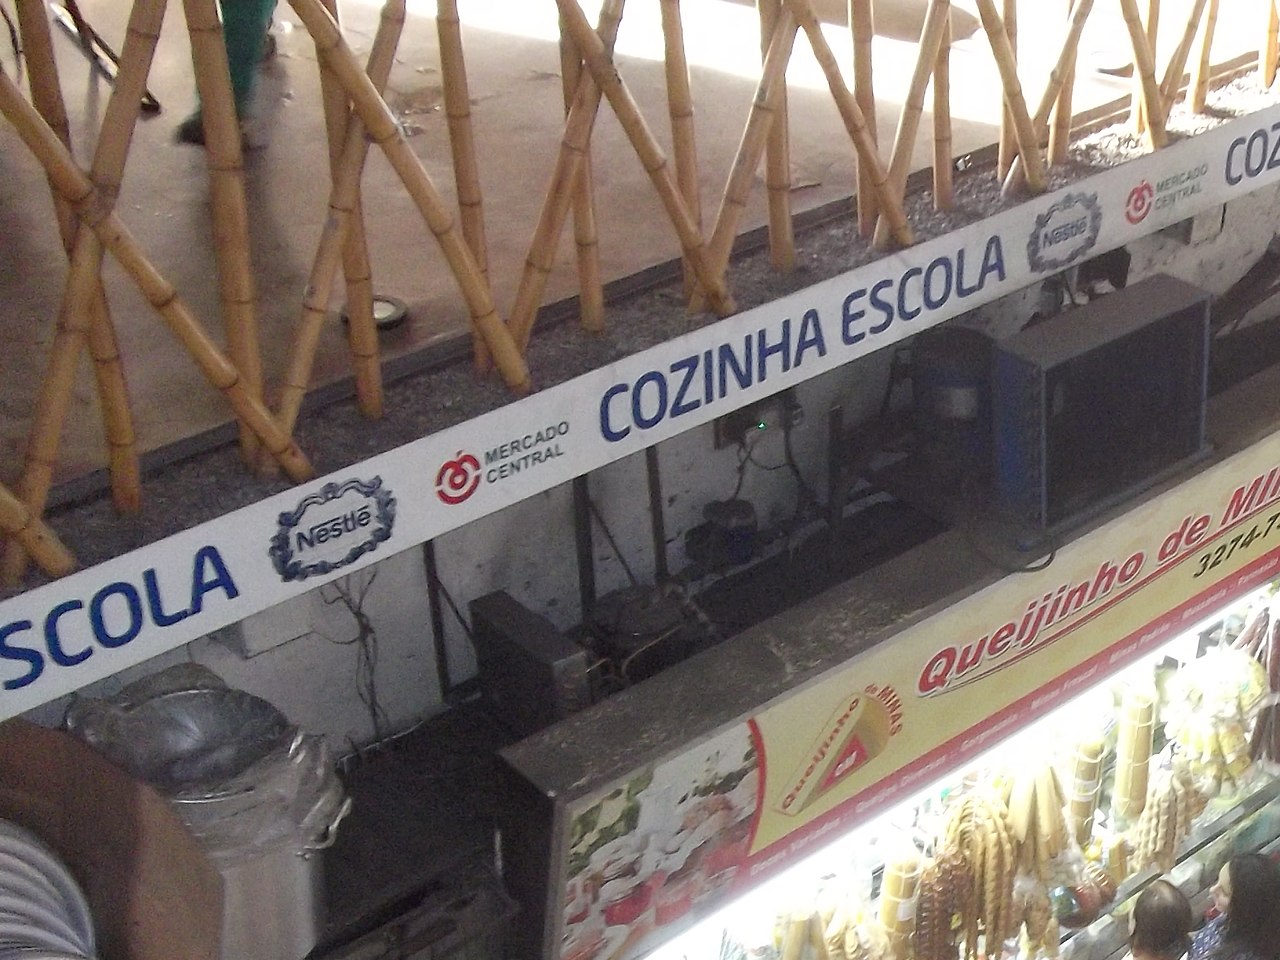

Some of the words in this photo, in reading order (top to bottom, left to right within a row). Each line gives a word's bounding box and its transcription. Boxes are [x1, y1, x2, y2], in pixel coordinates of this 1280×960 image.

[1155, 183, 1202, 211] CENTRAL
[1156, 164, 1208, 192] MERCADO
[600, 308, 828, 443] COZINHA
[841, 235, 1007, 346] ESCOLA
[484, 421, 570, 466] MERCADO
[486, 444, 564, 484] CENTRAL
[917, 549, 1148, 696] Queijinho
[1157, 514, 1212, 564] de
[877, 684, 903, 737] MINAS
